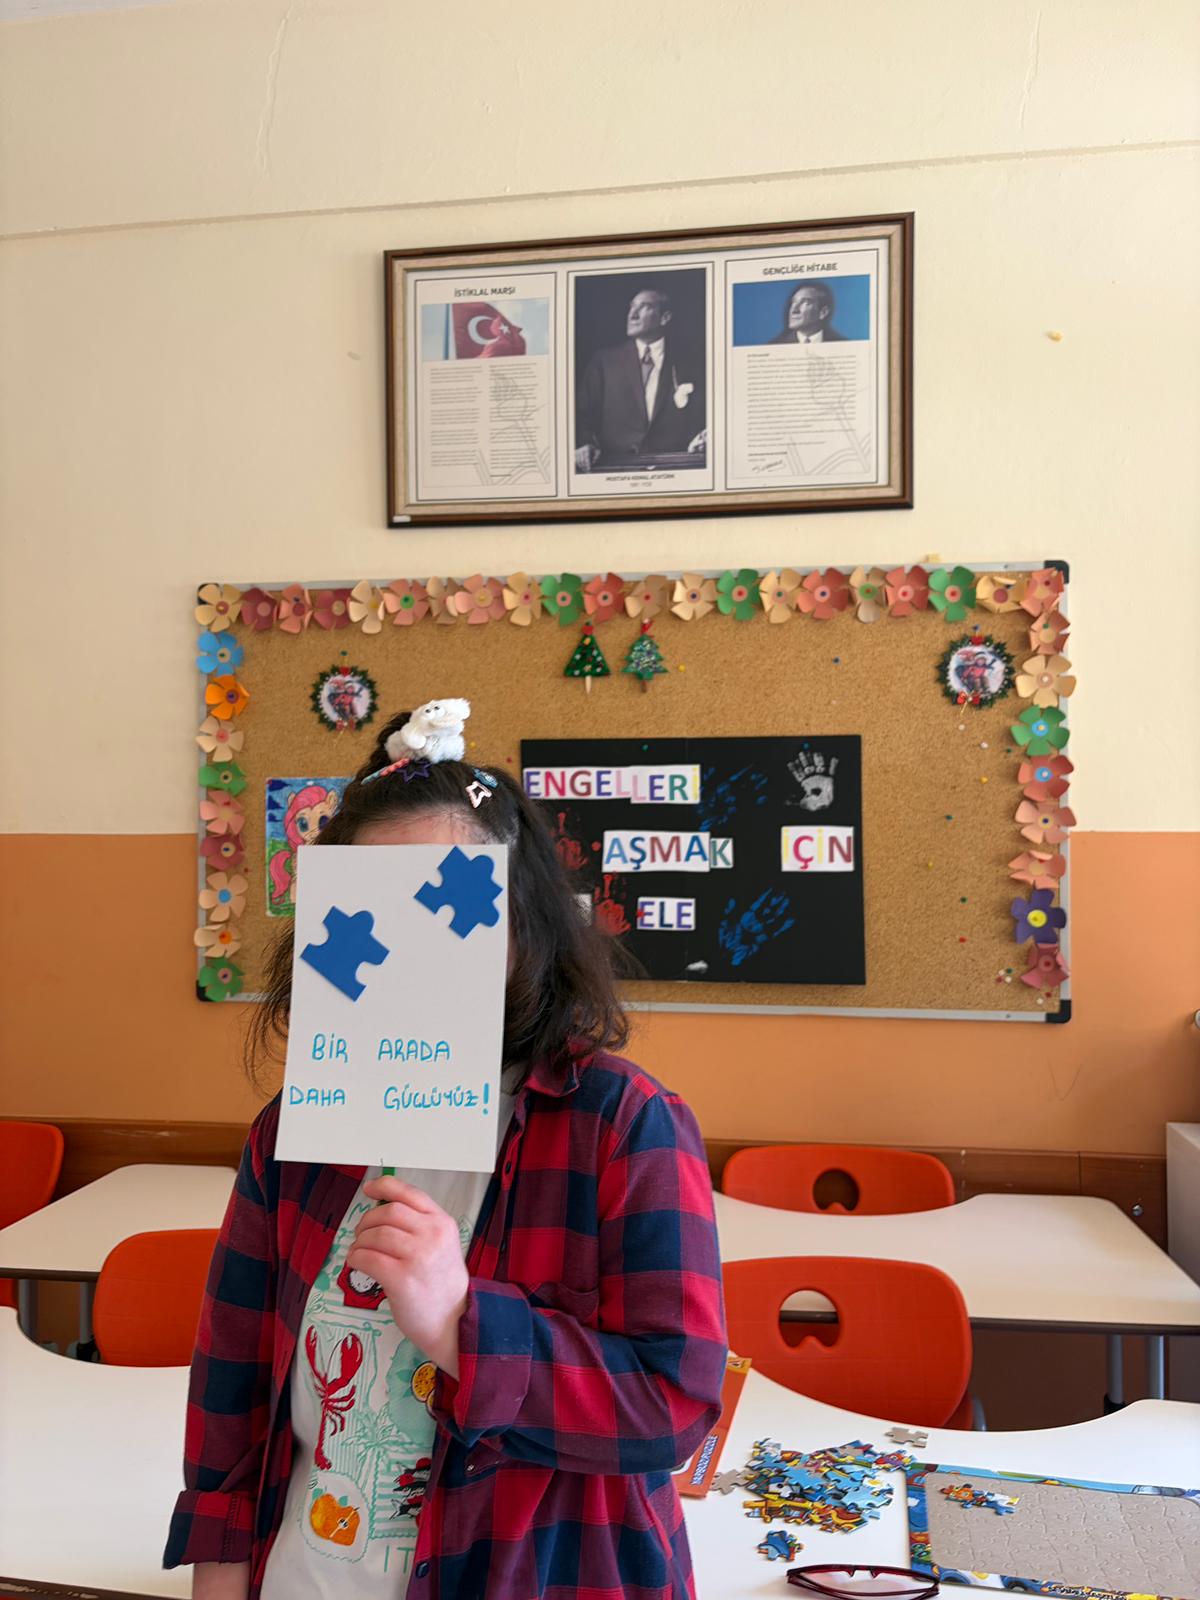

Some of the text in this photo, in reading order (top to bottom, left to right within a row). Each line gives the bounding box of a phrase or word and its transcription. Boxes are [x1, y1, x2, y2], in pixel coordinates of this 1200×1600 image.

[762, 261, 838, 276] GENÇLİĞE HİTABE
[490, 286, 516, 296] MARŞI
[525, 767, 699, 802] ENGELLERİ
[604, 828, 853, 870] AŞMAK İÇİN
[639, 900, 693, 929] ELE
[311, 1032, 451, 1064] BİR ARADA
[288, 1084, 346, 1107] DAHA
